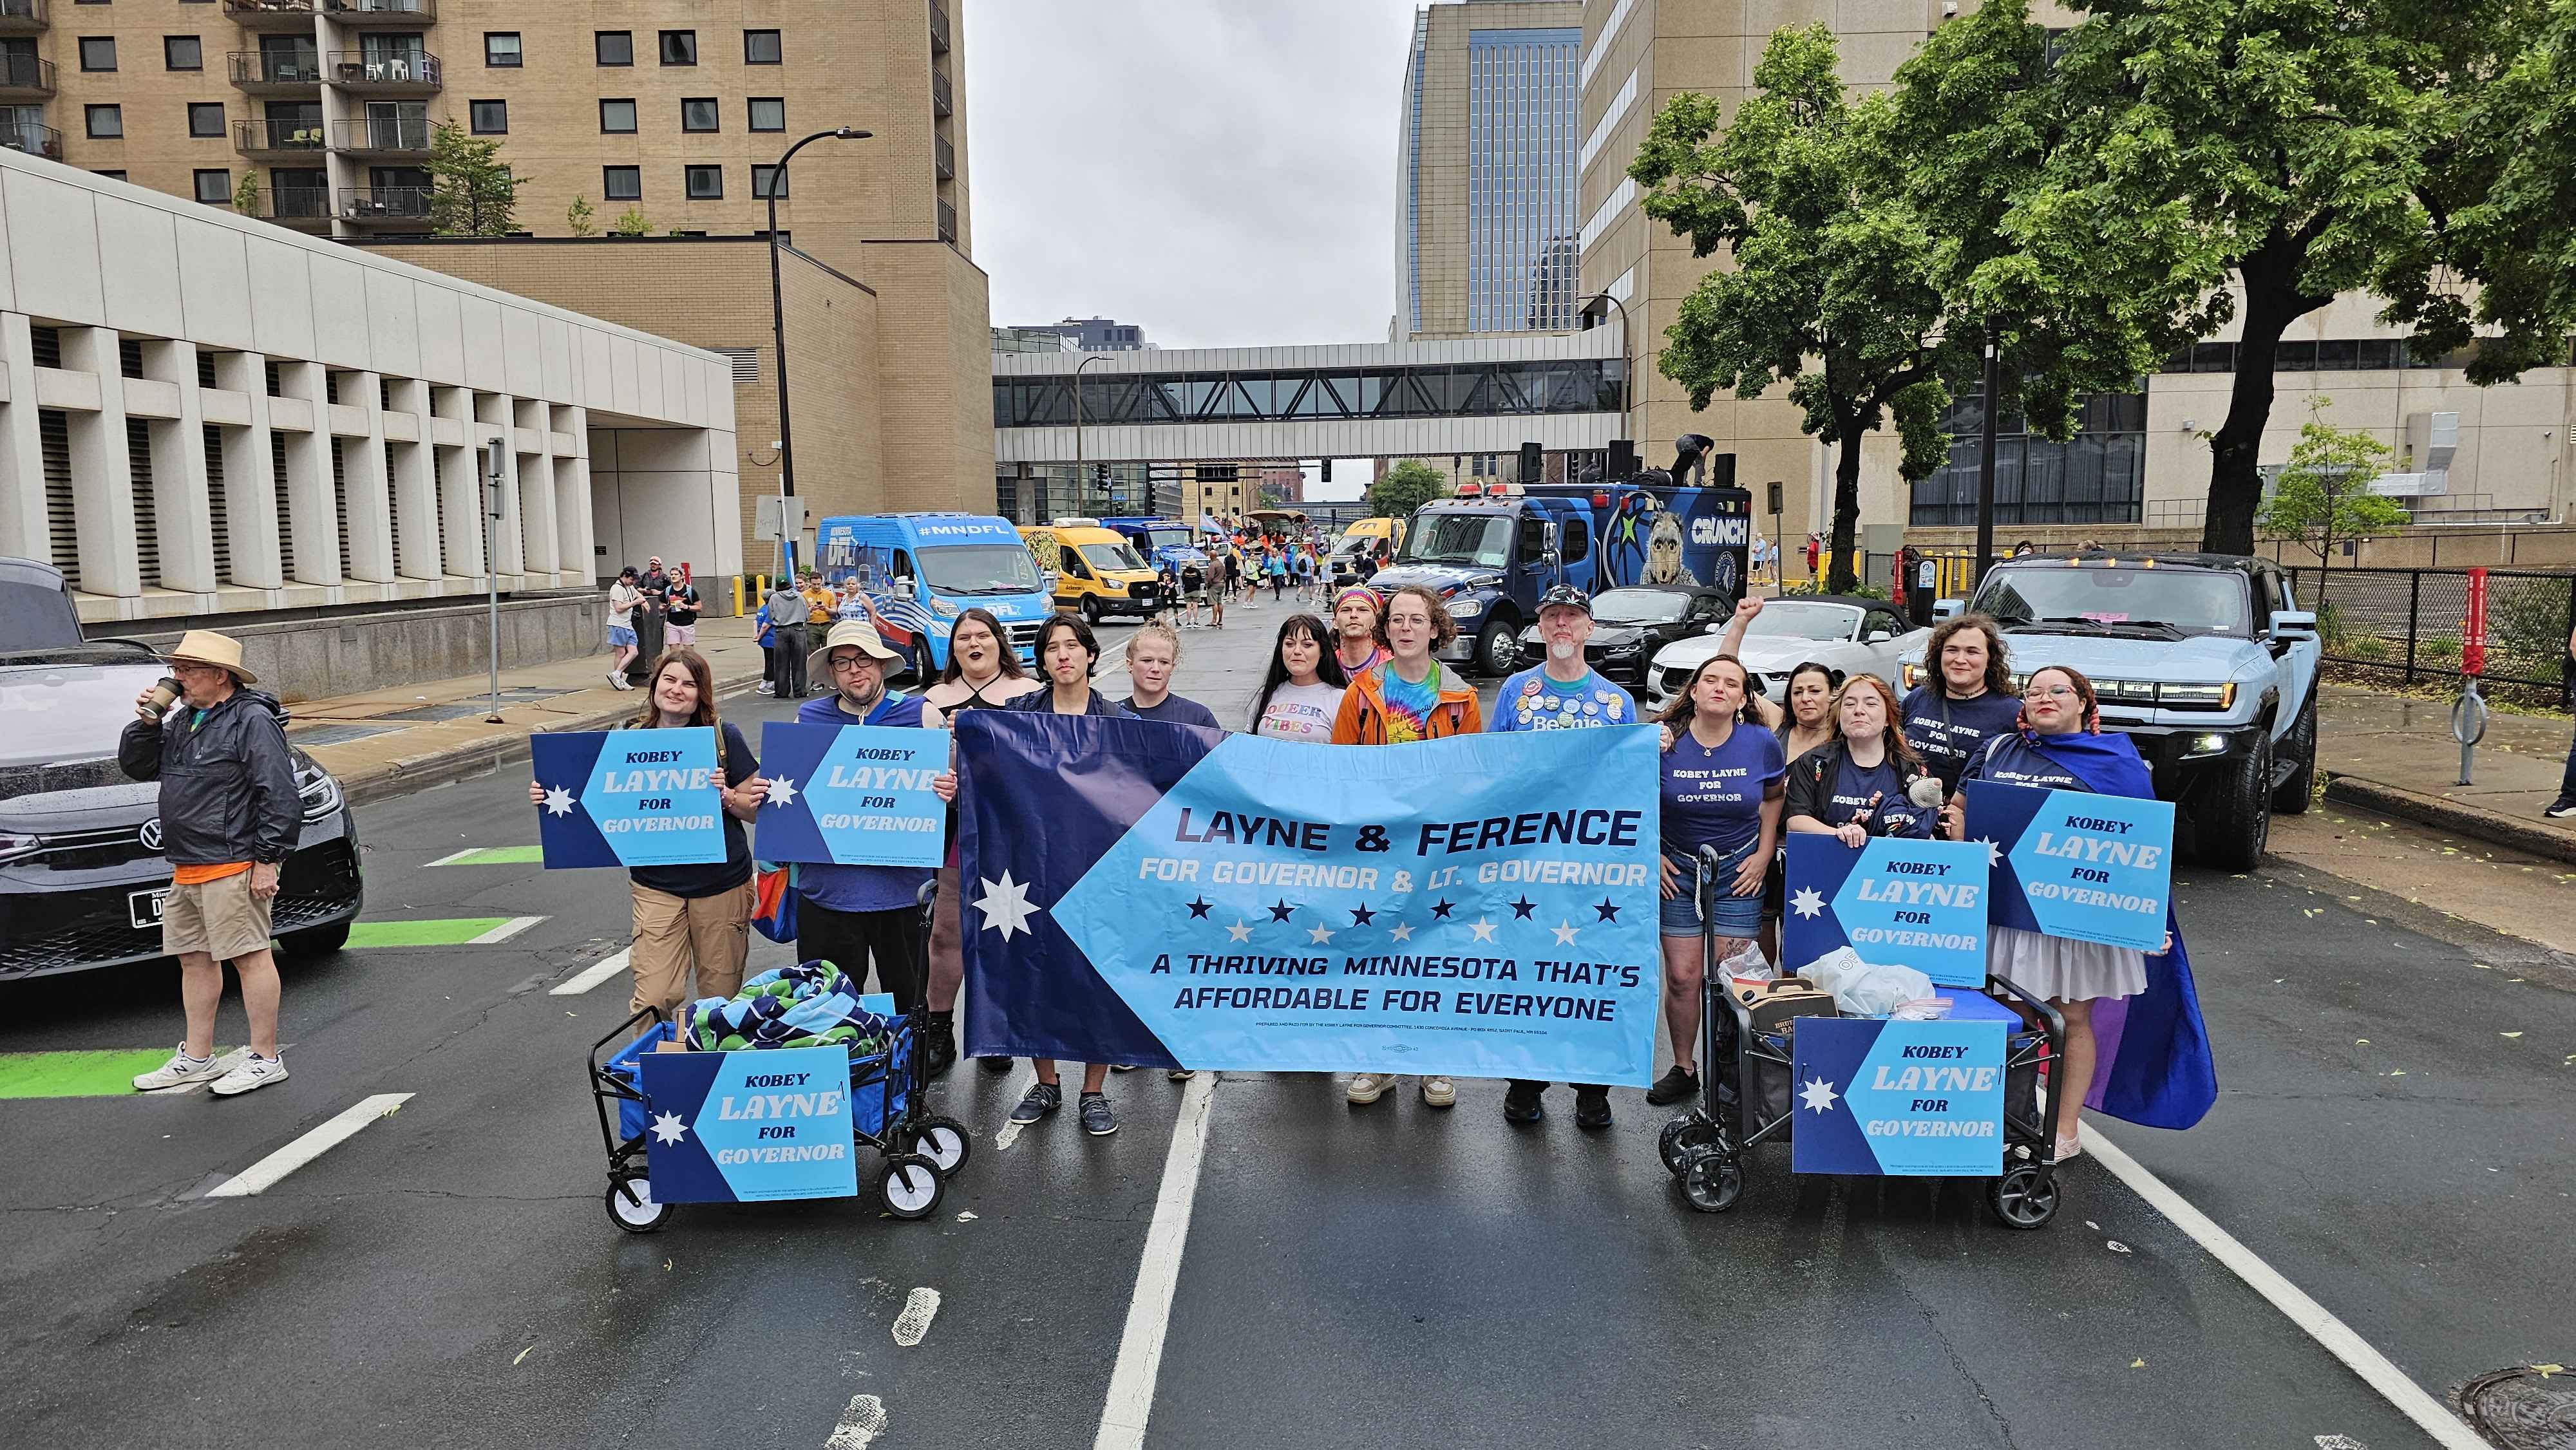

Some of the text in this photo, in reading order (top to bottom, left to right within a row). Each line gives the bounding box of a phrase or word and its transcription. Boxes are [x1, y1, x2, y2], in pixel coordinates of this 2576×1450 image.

[919, 525, 1009, 536] #MNDFL
[1692, 517, 1747, 544] CRUNCH
[828, 536, 852, 566] DFL
[2479, 576, 2484, 588] NO
[983, 602, 1018, 616] DFL
[1265, 718, 1313, 733] VIBES
[1532, 716, 1602, 731] Benie
[1913, 717, 1980, 737] KOBEY AYNE
[625, 751, 683, 764] KOBEY
[855, 748, 915, 761] KOBEY
[602, 768, 710, 793] LAYNE
[826, 765, 940, 791] LAYNE
[1673, 768, 1747, 778] KOBEY LAYNE
[1994, 771, 2072, 785] KOBEY LAYNE
[1699, 781, 1721, 789] FOR
[638, 798, 671, 810] FOR
[860, 796, 896, 809] FOR
[1677, 793, 1742, 803] GOVERNOR
[1832, 795, 1867, 805] KOBEY
[603, 815, 714, 833] GOVERNOR
[820, 814, 937, 832] GOVERNOR
[2065, 816, 2133, 834] KOBEY
[1175, 807, 1642, 857] LAYNE & FERENCE
[2034, 832, 2162, 870] LAYNE
[1139, 858, 1647, 893] FOR GOVERNOR & LT. GOVERNOR
[1886, 861, 1951, 876] KOBEY
[2070, 867, 2110, 883] FOR
[1857, 878, 1979, 908] LAYNE
[2027, 881, 2158, 914] GOVERNOR
[1893, 910, 1931, 925] FOR
[1852, 927, 1977, 951] GOVERNOR
[1150, 954, 1640, 988] A THRIVING MINNESOTA THAT'S
[1173, 988, 1616, 1022] AFFORDABLE FOR EVERYONE
[1901, 1046, 1969, 1059] KOBEY
[744, 1073, 810, 1088] KOBEY
[1871, 1066, 1996, 1091] LAYNE
[718, 1091, 842, 1120] LAYNE
[1910, 1099, 1948, 1112] FOR
[758, 1125, 795, 1140] FOR
[1867, 1120, 1994, 1137] GOVERNOR
[717, 1144, 845, 1165] GOVERNOR
